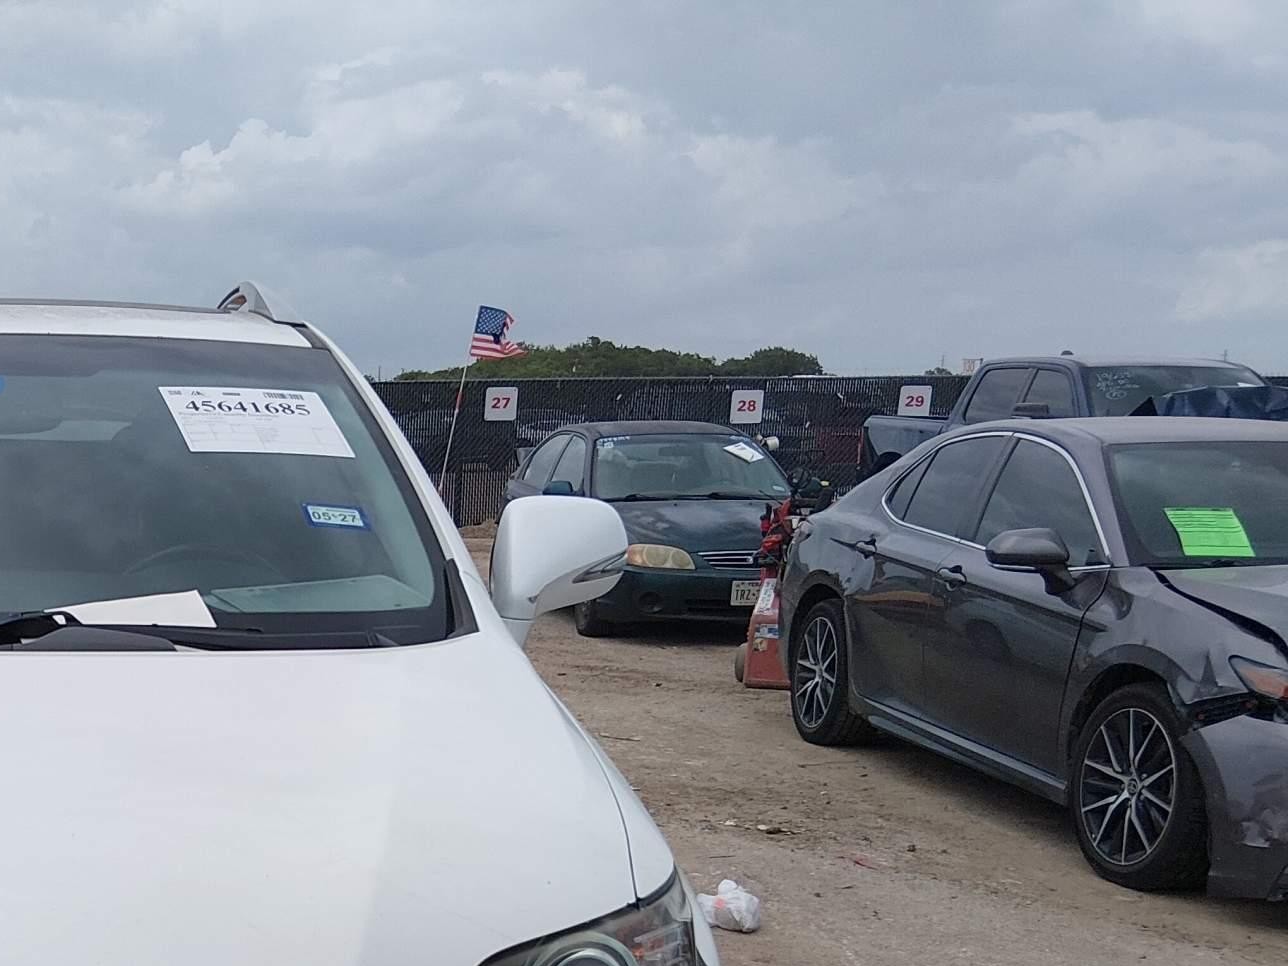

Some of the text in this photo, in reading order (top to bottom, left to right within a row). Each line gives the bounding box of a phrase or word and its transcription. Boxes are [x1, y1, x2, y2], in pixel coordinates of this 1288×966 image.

[491, 396, 511, 409] 27
[737, 399, 756, 412] 28
[904, 395, 925, 407] 29
[185, 400, 311, 416] 45641685
